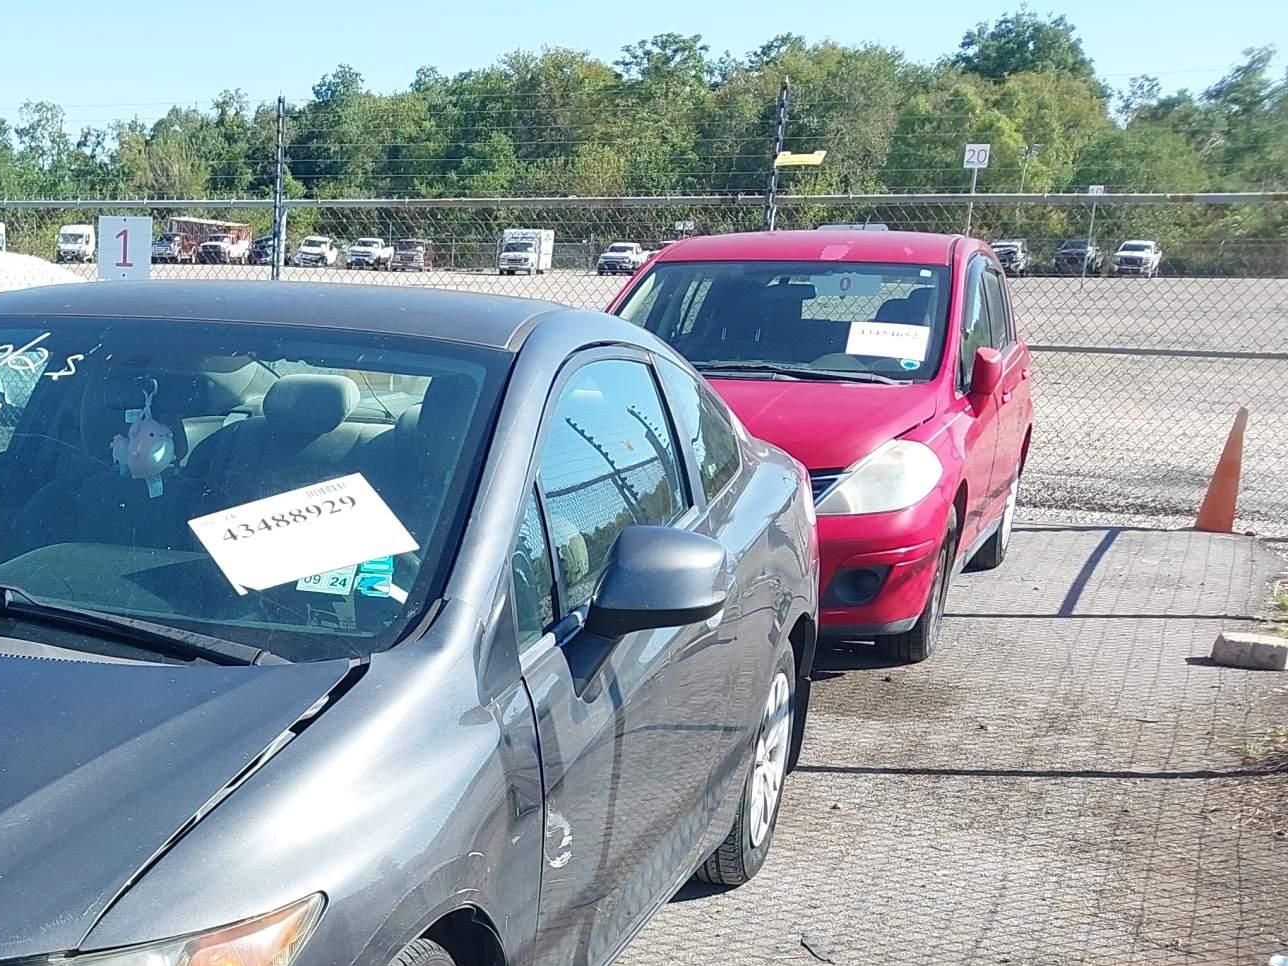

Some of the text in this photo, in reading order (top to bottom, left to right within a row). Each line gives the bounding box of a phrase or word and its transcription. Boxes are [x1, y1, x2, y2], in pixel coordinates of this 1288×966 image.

[966, 148, 988, 164] 20
[115, 229, 134, 267] 1
[222, 495, 357, 542] 43488929
[329, 576, 347, 588] 24
